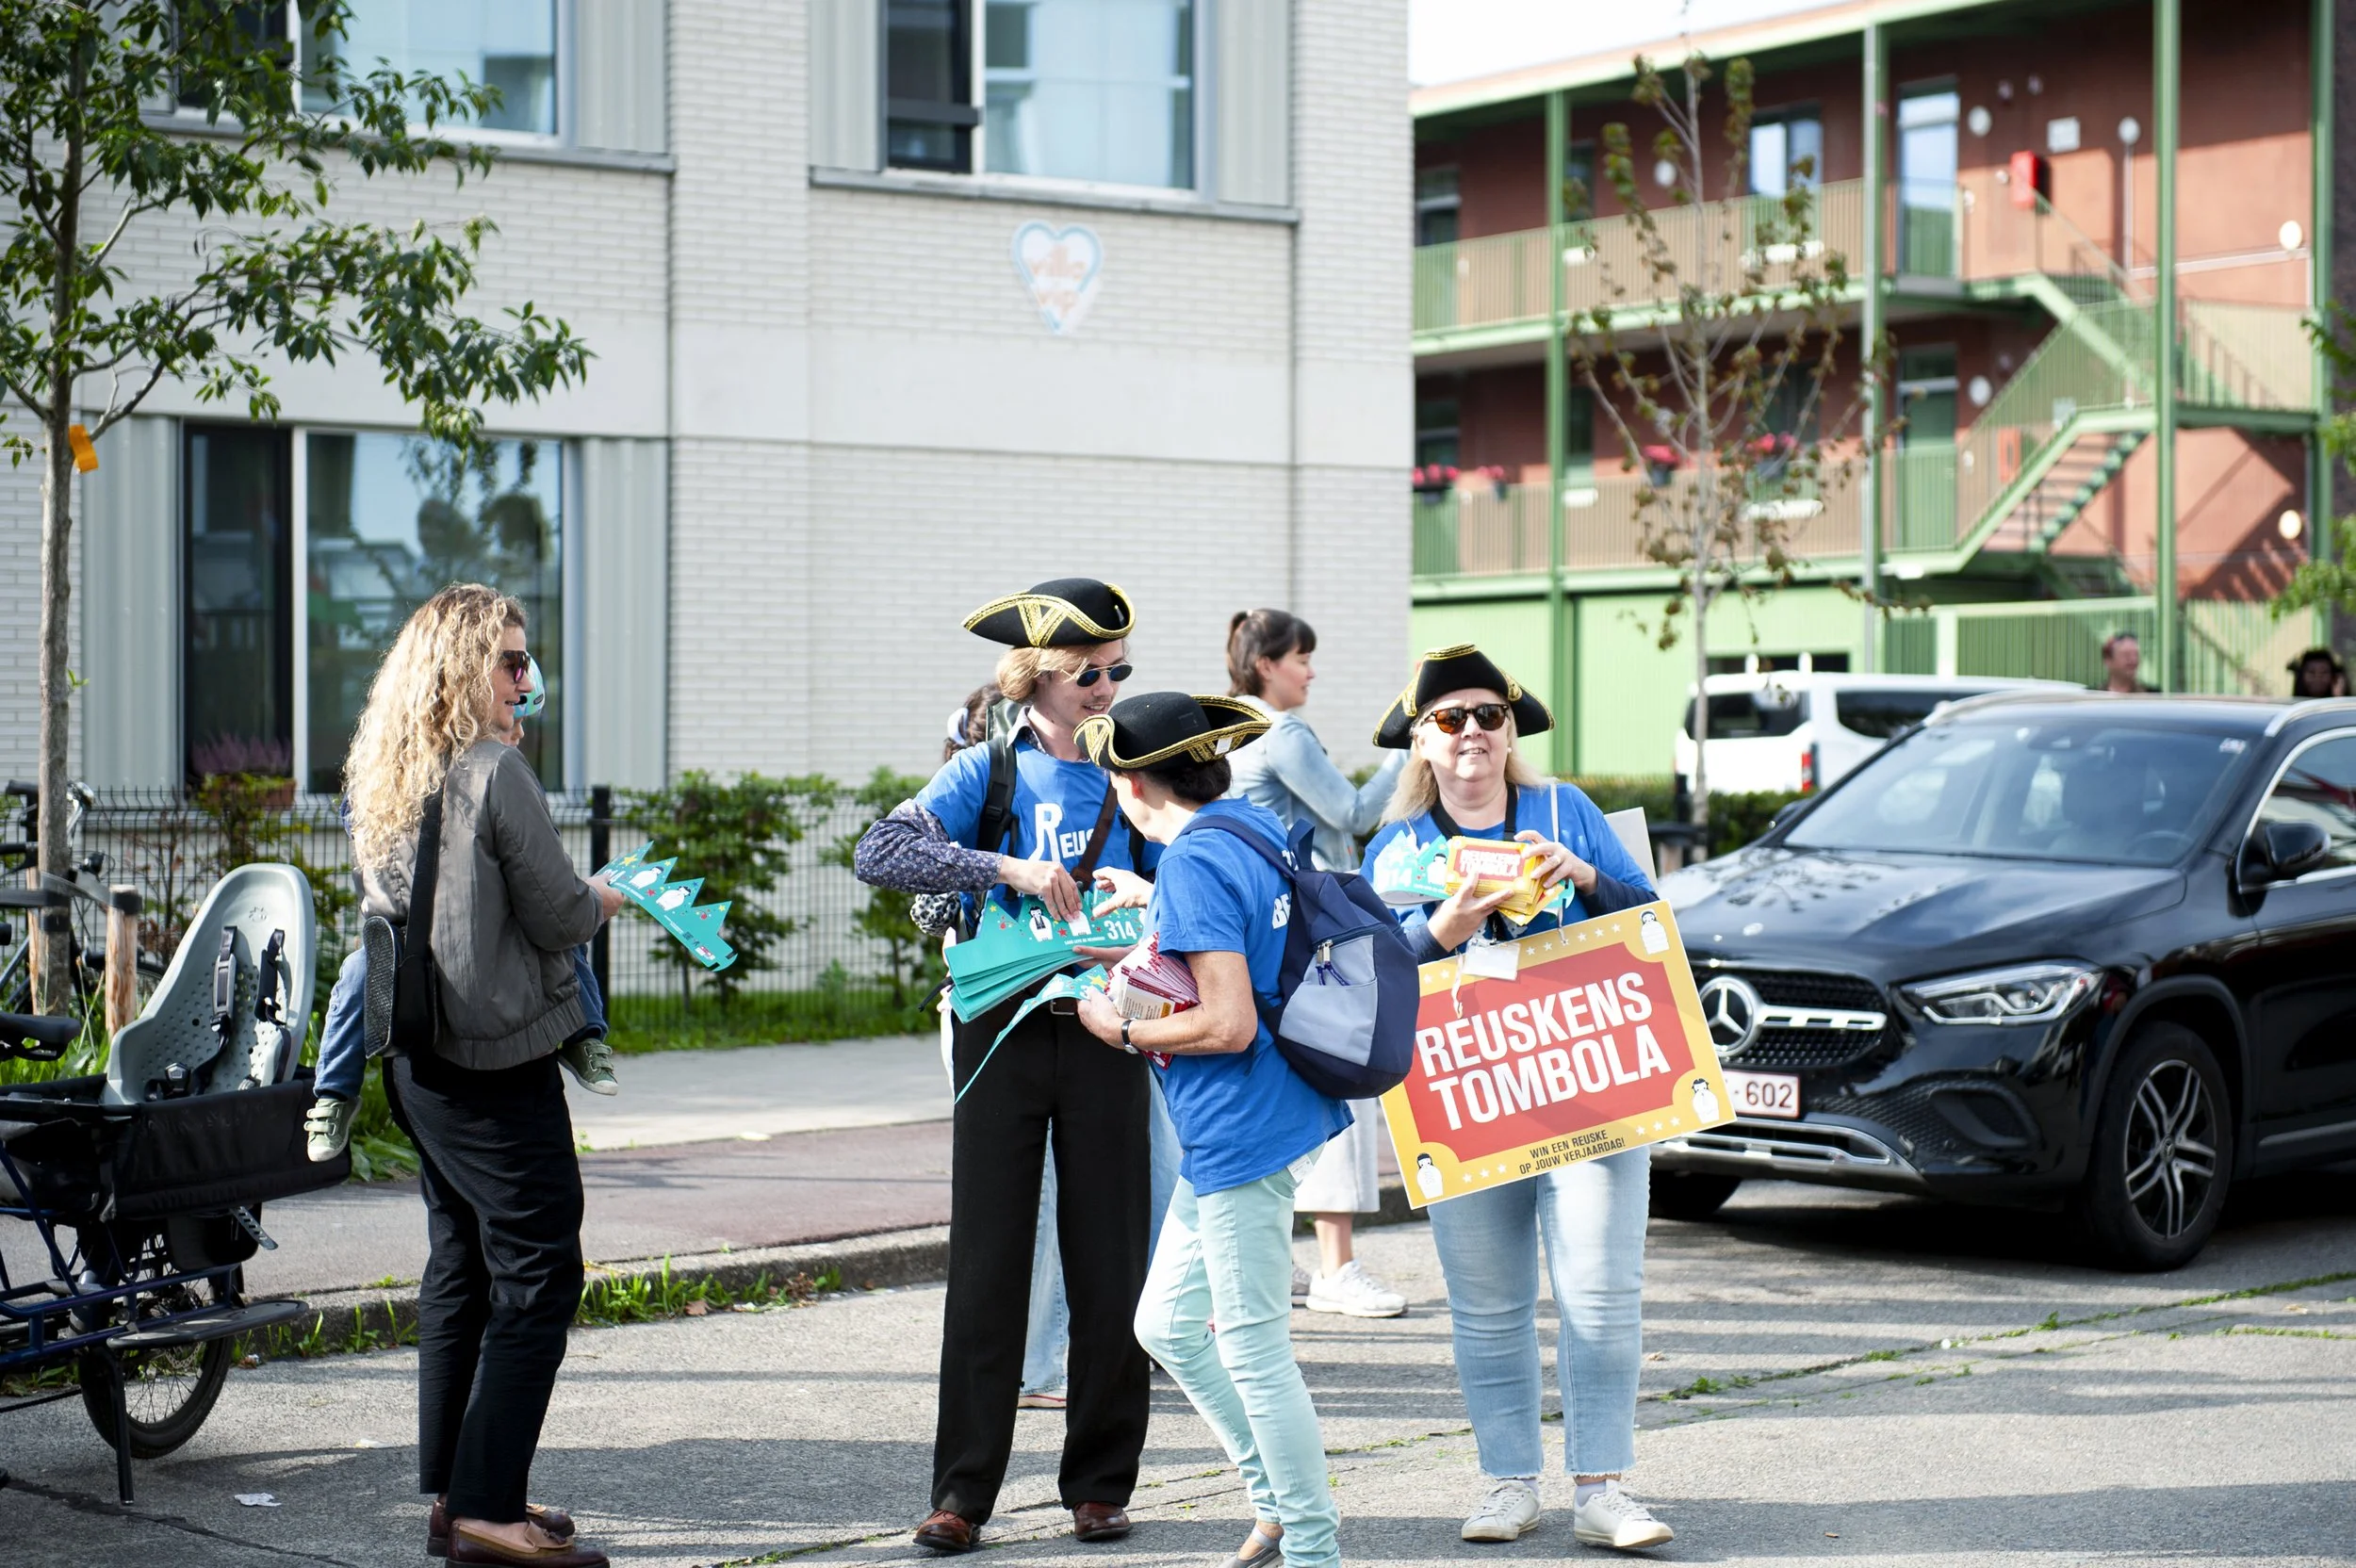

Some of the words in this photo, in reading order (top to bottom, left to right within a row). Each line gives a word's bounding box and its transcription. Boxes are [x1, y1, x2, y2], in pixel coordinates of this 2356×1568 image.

[1104, 920, 1137, 940] 314
[1415, 972, 1653, 1078] REUSKENS
[1429, 1024, 1672, 1132] TOMBOLA
[1519, 1163, 1531, 1174] OP
[1535, 1155, 1561, 1170] JOUW
[1563, 1137, 1626, 1162] VERJAARDAG!
[1530, 1145, 1549, 1159] WIN
[1551, 1140, 1569, 1153] EEN
[1572, 1130, 1608, 1147] REUSKE
